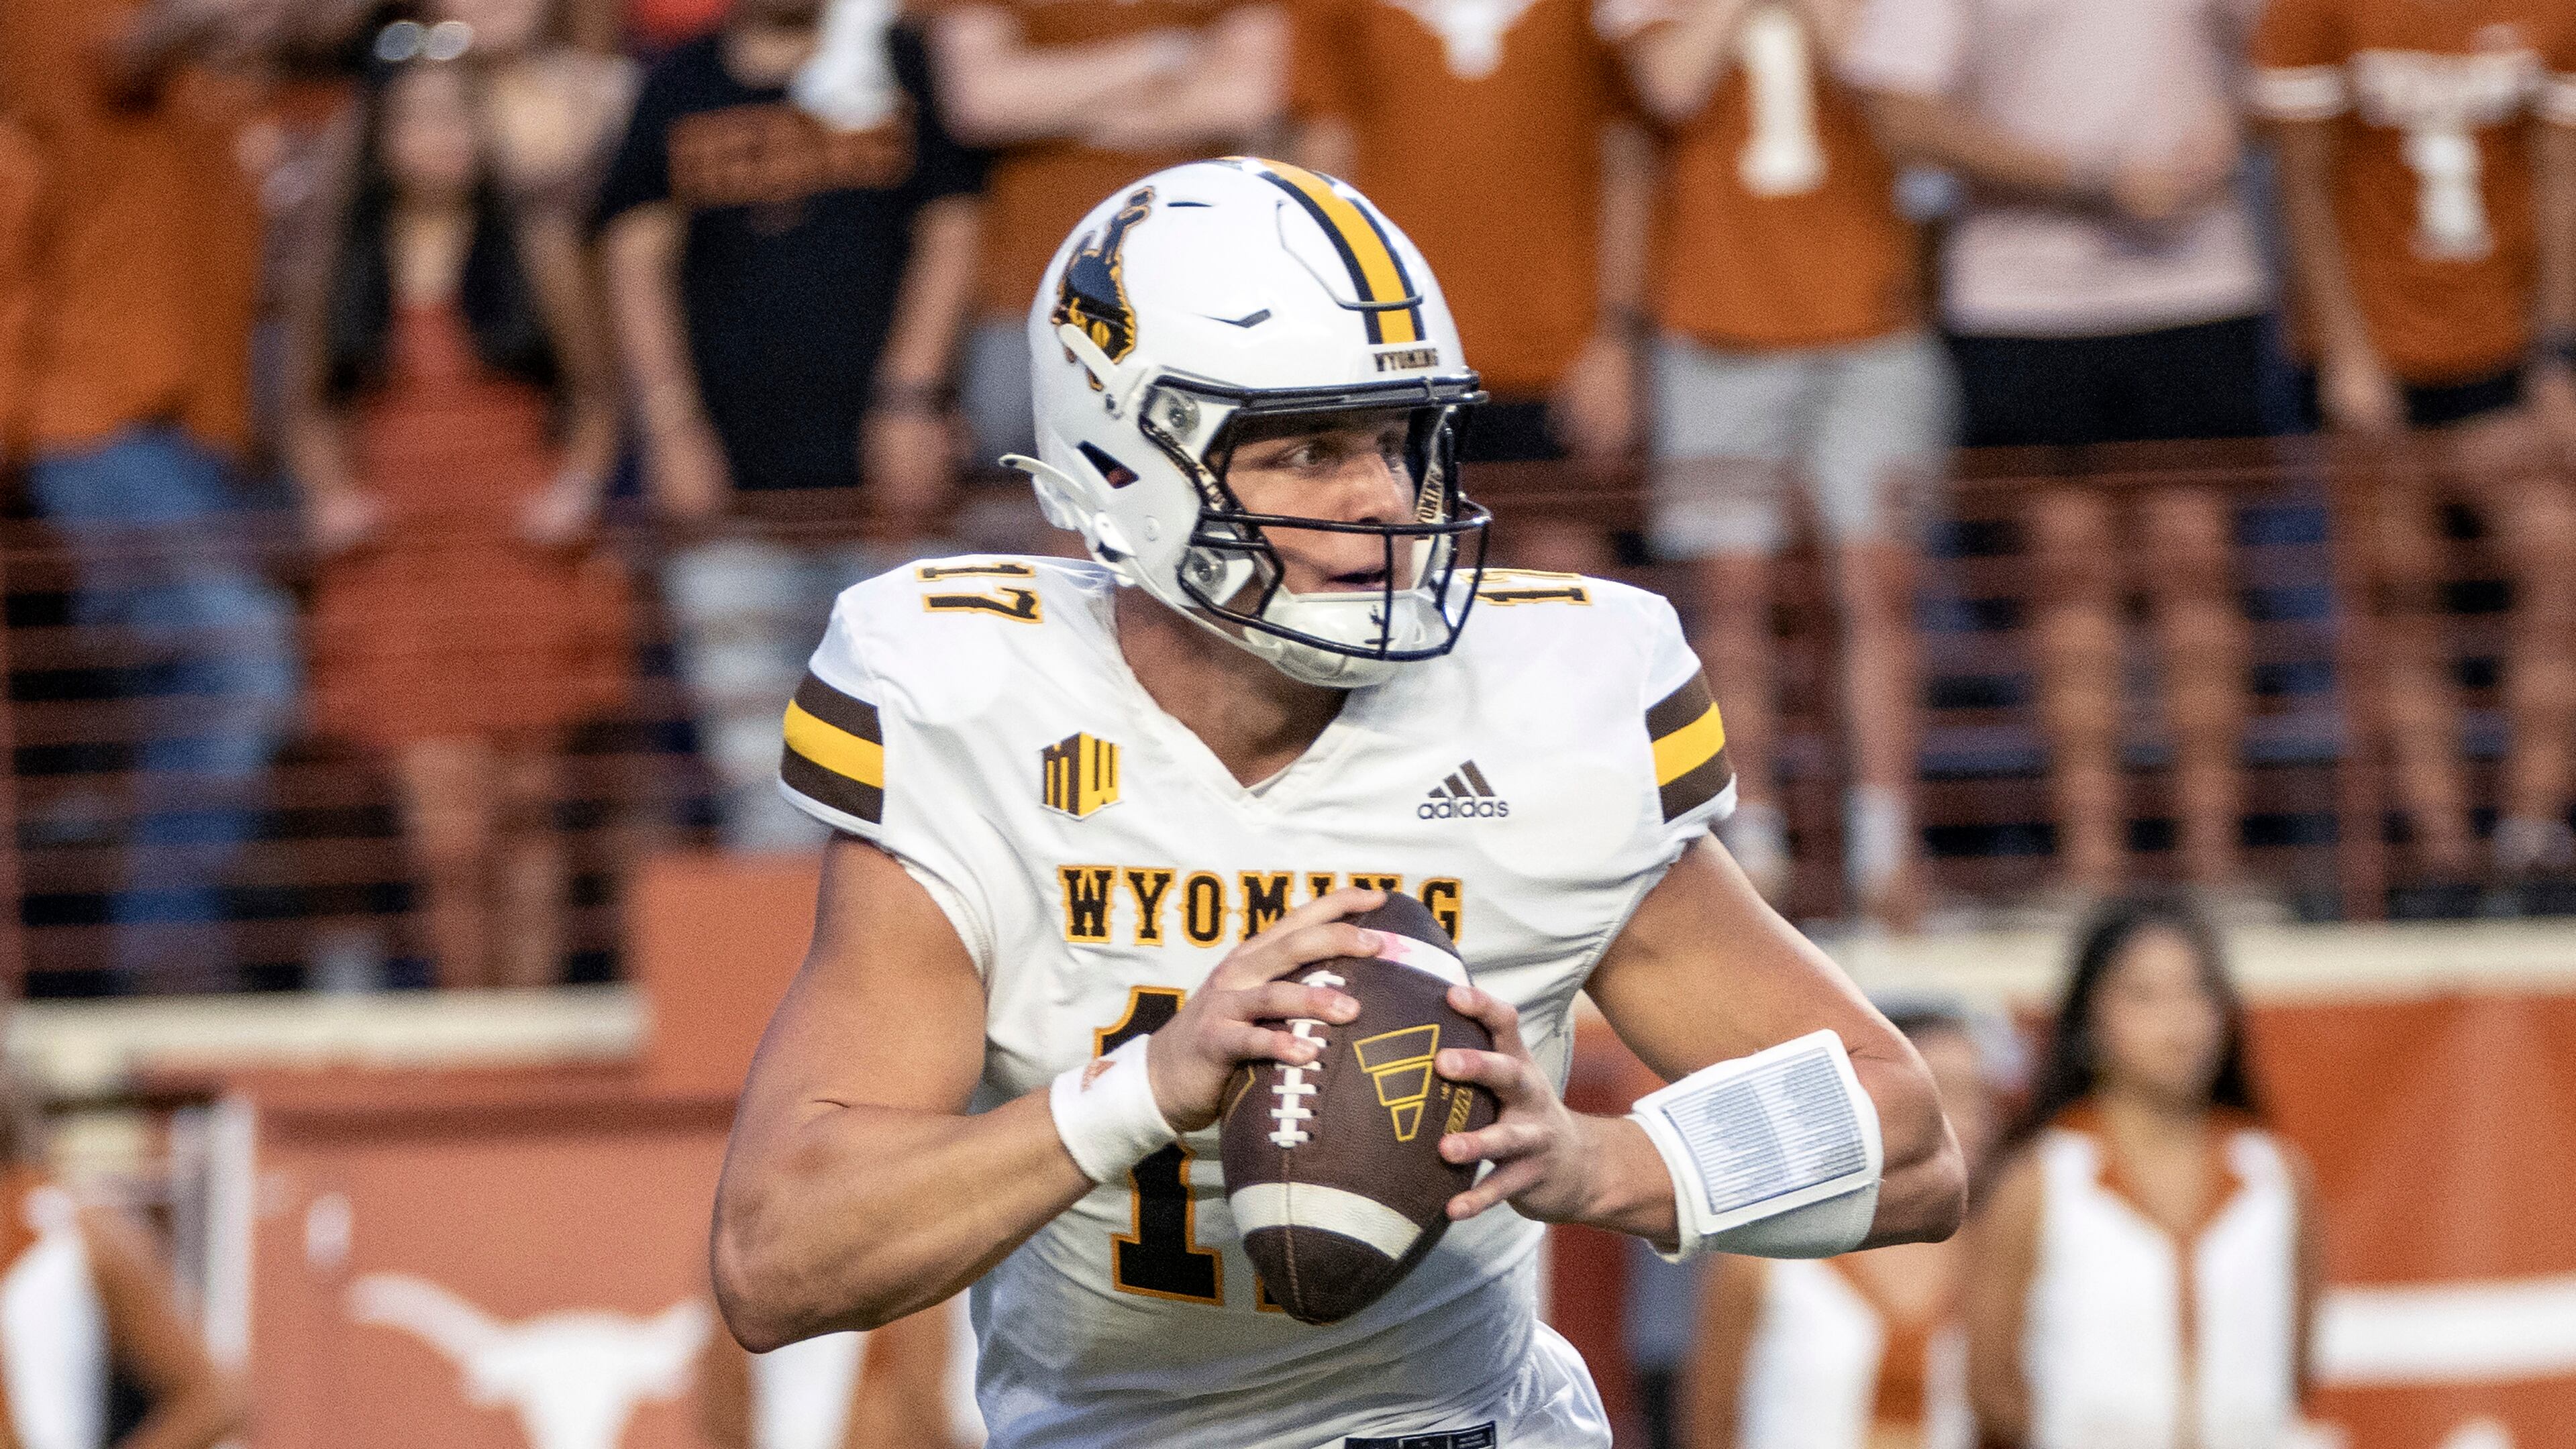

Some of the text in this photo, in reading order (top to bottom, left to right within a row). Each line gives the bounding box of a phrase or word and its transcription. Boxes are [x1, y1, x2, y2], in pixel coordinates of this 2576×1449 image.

[915, 562, 1044, 624] 17
[1417, 797, 1508, 820] adidas
[1058, 864, 1463, 947] WYOMG
